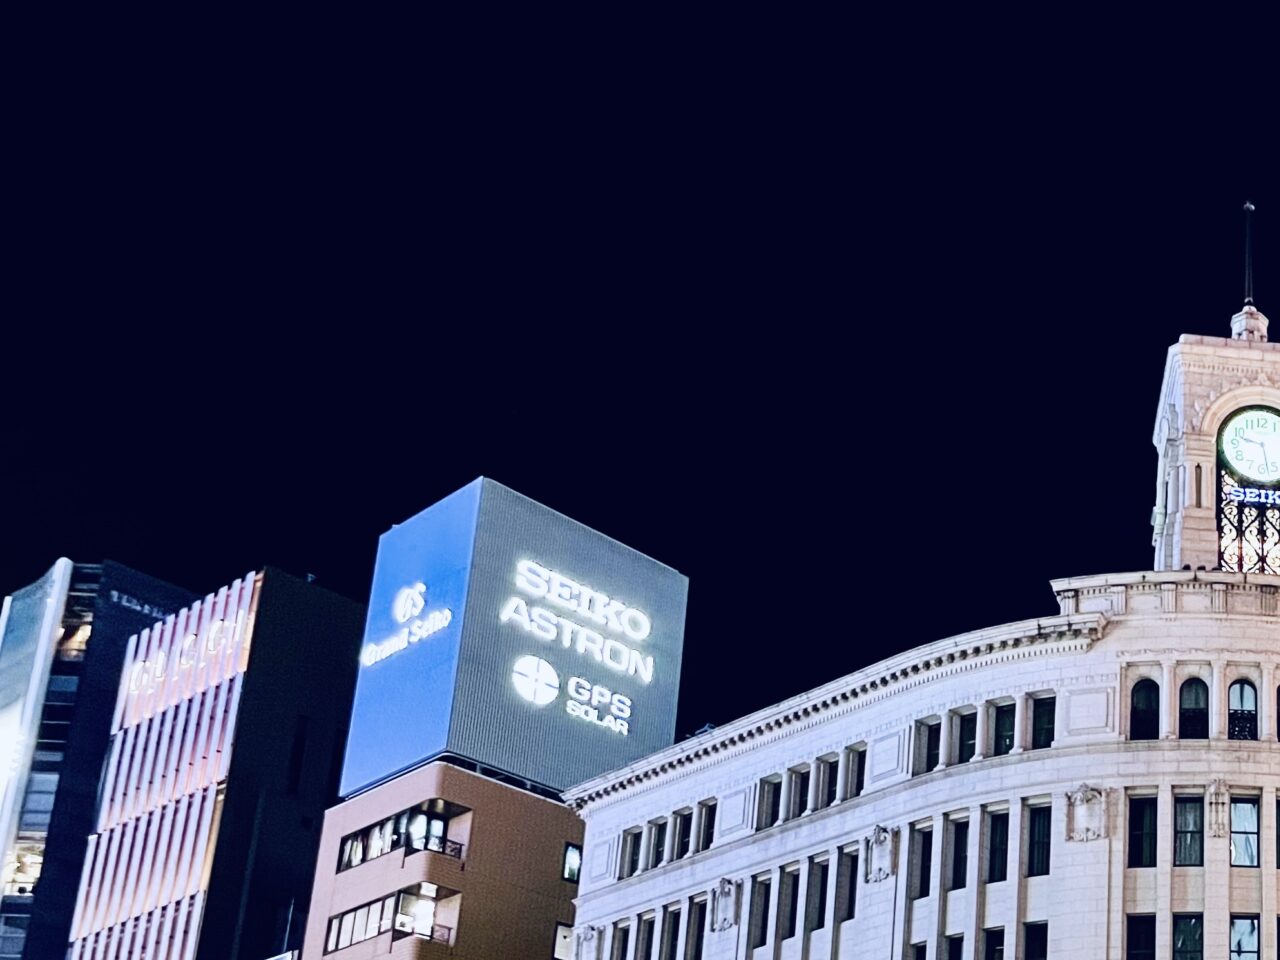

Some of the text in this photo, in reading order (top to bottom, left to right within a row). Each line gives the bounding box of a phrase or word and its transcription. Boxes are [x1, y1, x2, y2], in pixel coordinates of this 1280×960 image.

[1245, 419, 1254, 430] 11
[1257, 417, 1268, 429] 12
[1234, 427, 1245, 438] 10
[1230, 438, 1239, 449] 9
[1235, 450, 1244, 461] 8
[1246, 459, 1255, 470] 7
[1257, 464, 1266, 475] 6
[1270, 462, 1278, 473] 5
[515, 559, 652, 641] SEIKO
[499, 596, 655, 684] ASTRON
[567, 676, 632, 719] GPS
[566, 699, 629, 736] SOLAR
